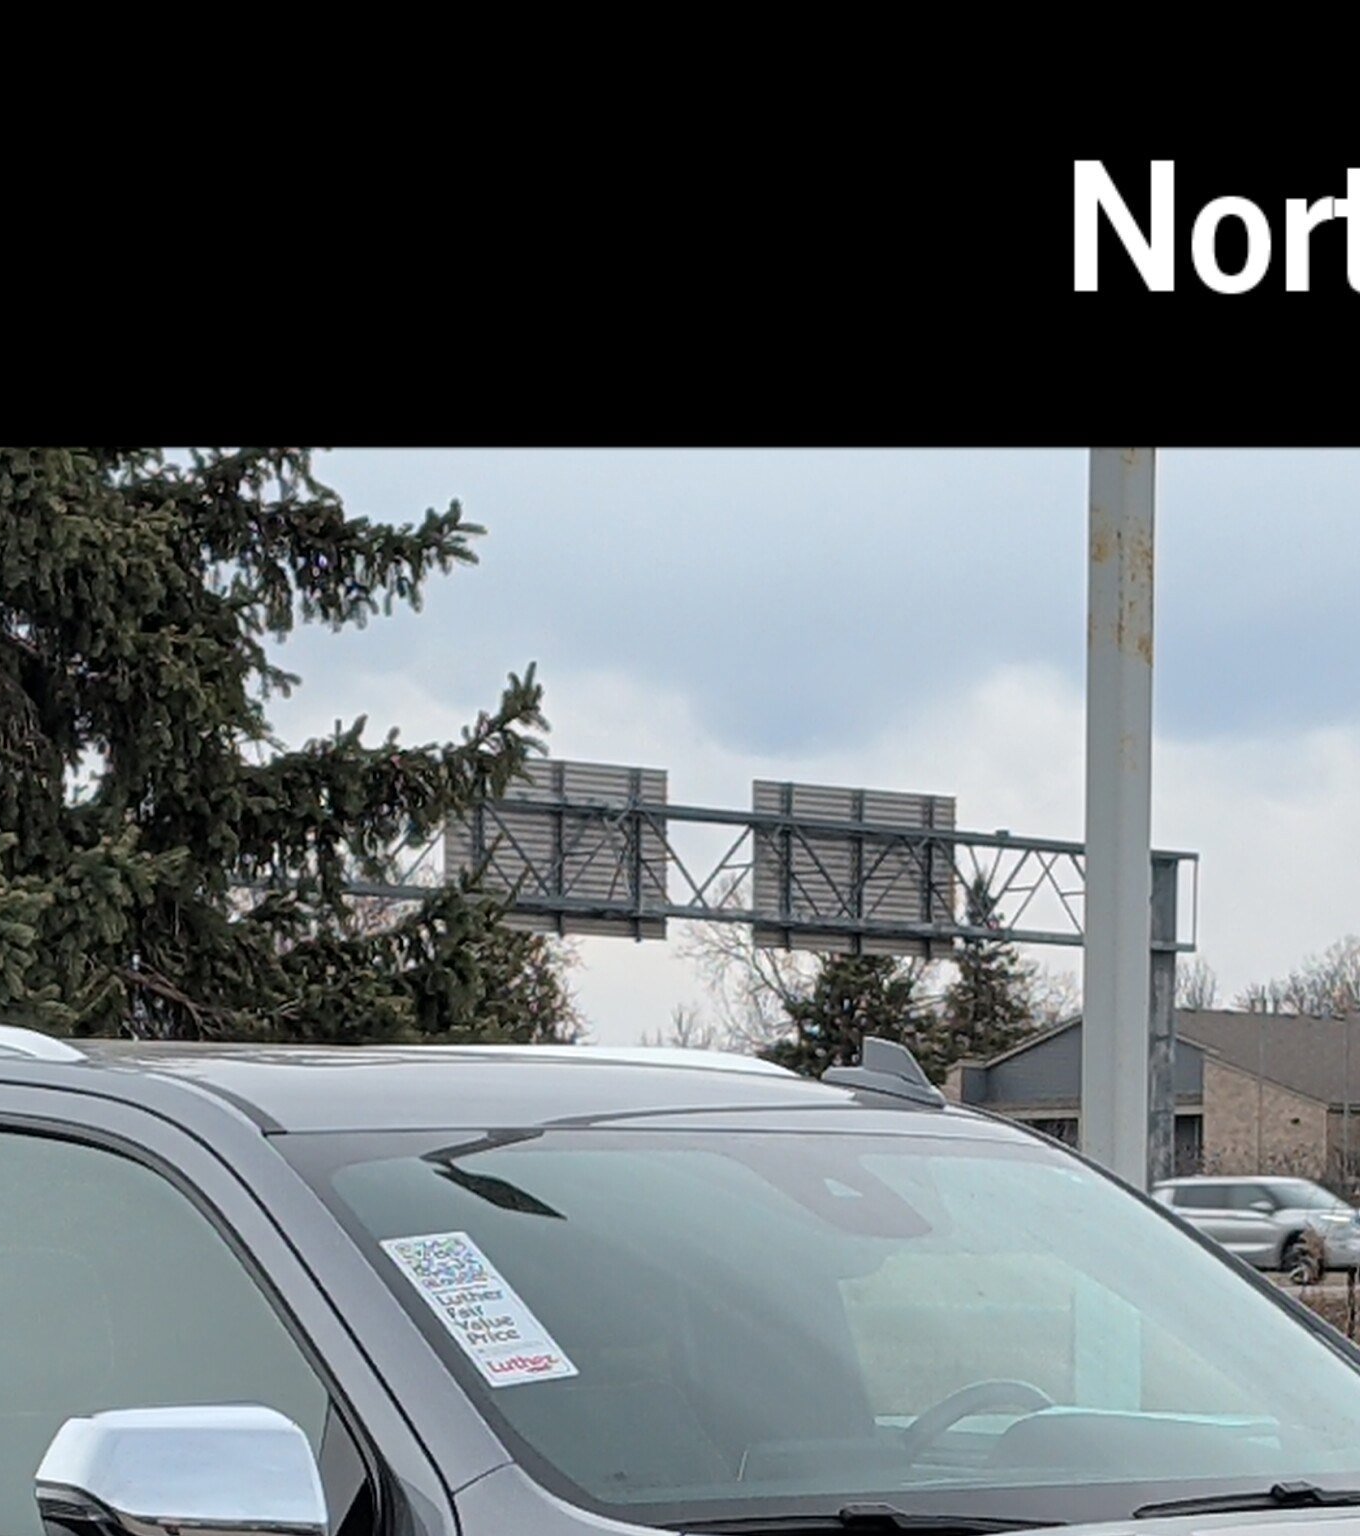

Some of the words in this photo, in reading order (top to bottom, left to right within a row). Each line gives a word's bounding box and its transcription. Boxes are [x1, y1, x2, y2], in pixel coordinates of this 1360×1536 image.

[436, 1289, 504, 1306] Luther
[446, 1304, 485, 1319] Fair
[456, 1314, 516, 1332] Value
[467, 1329, 520, 1345] Price
[487, 1353, 559, 1373] Luther
